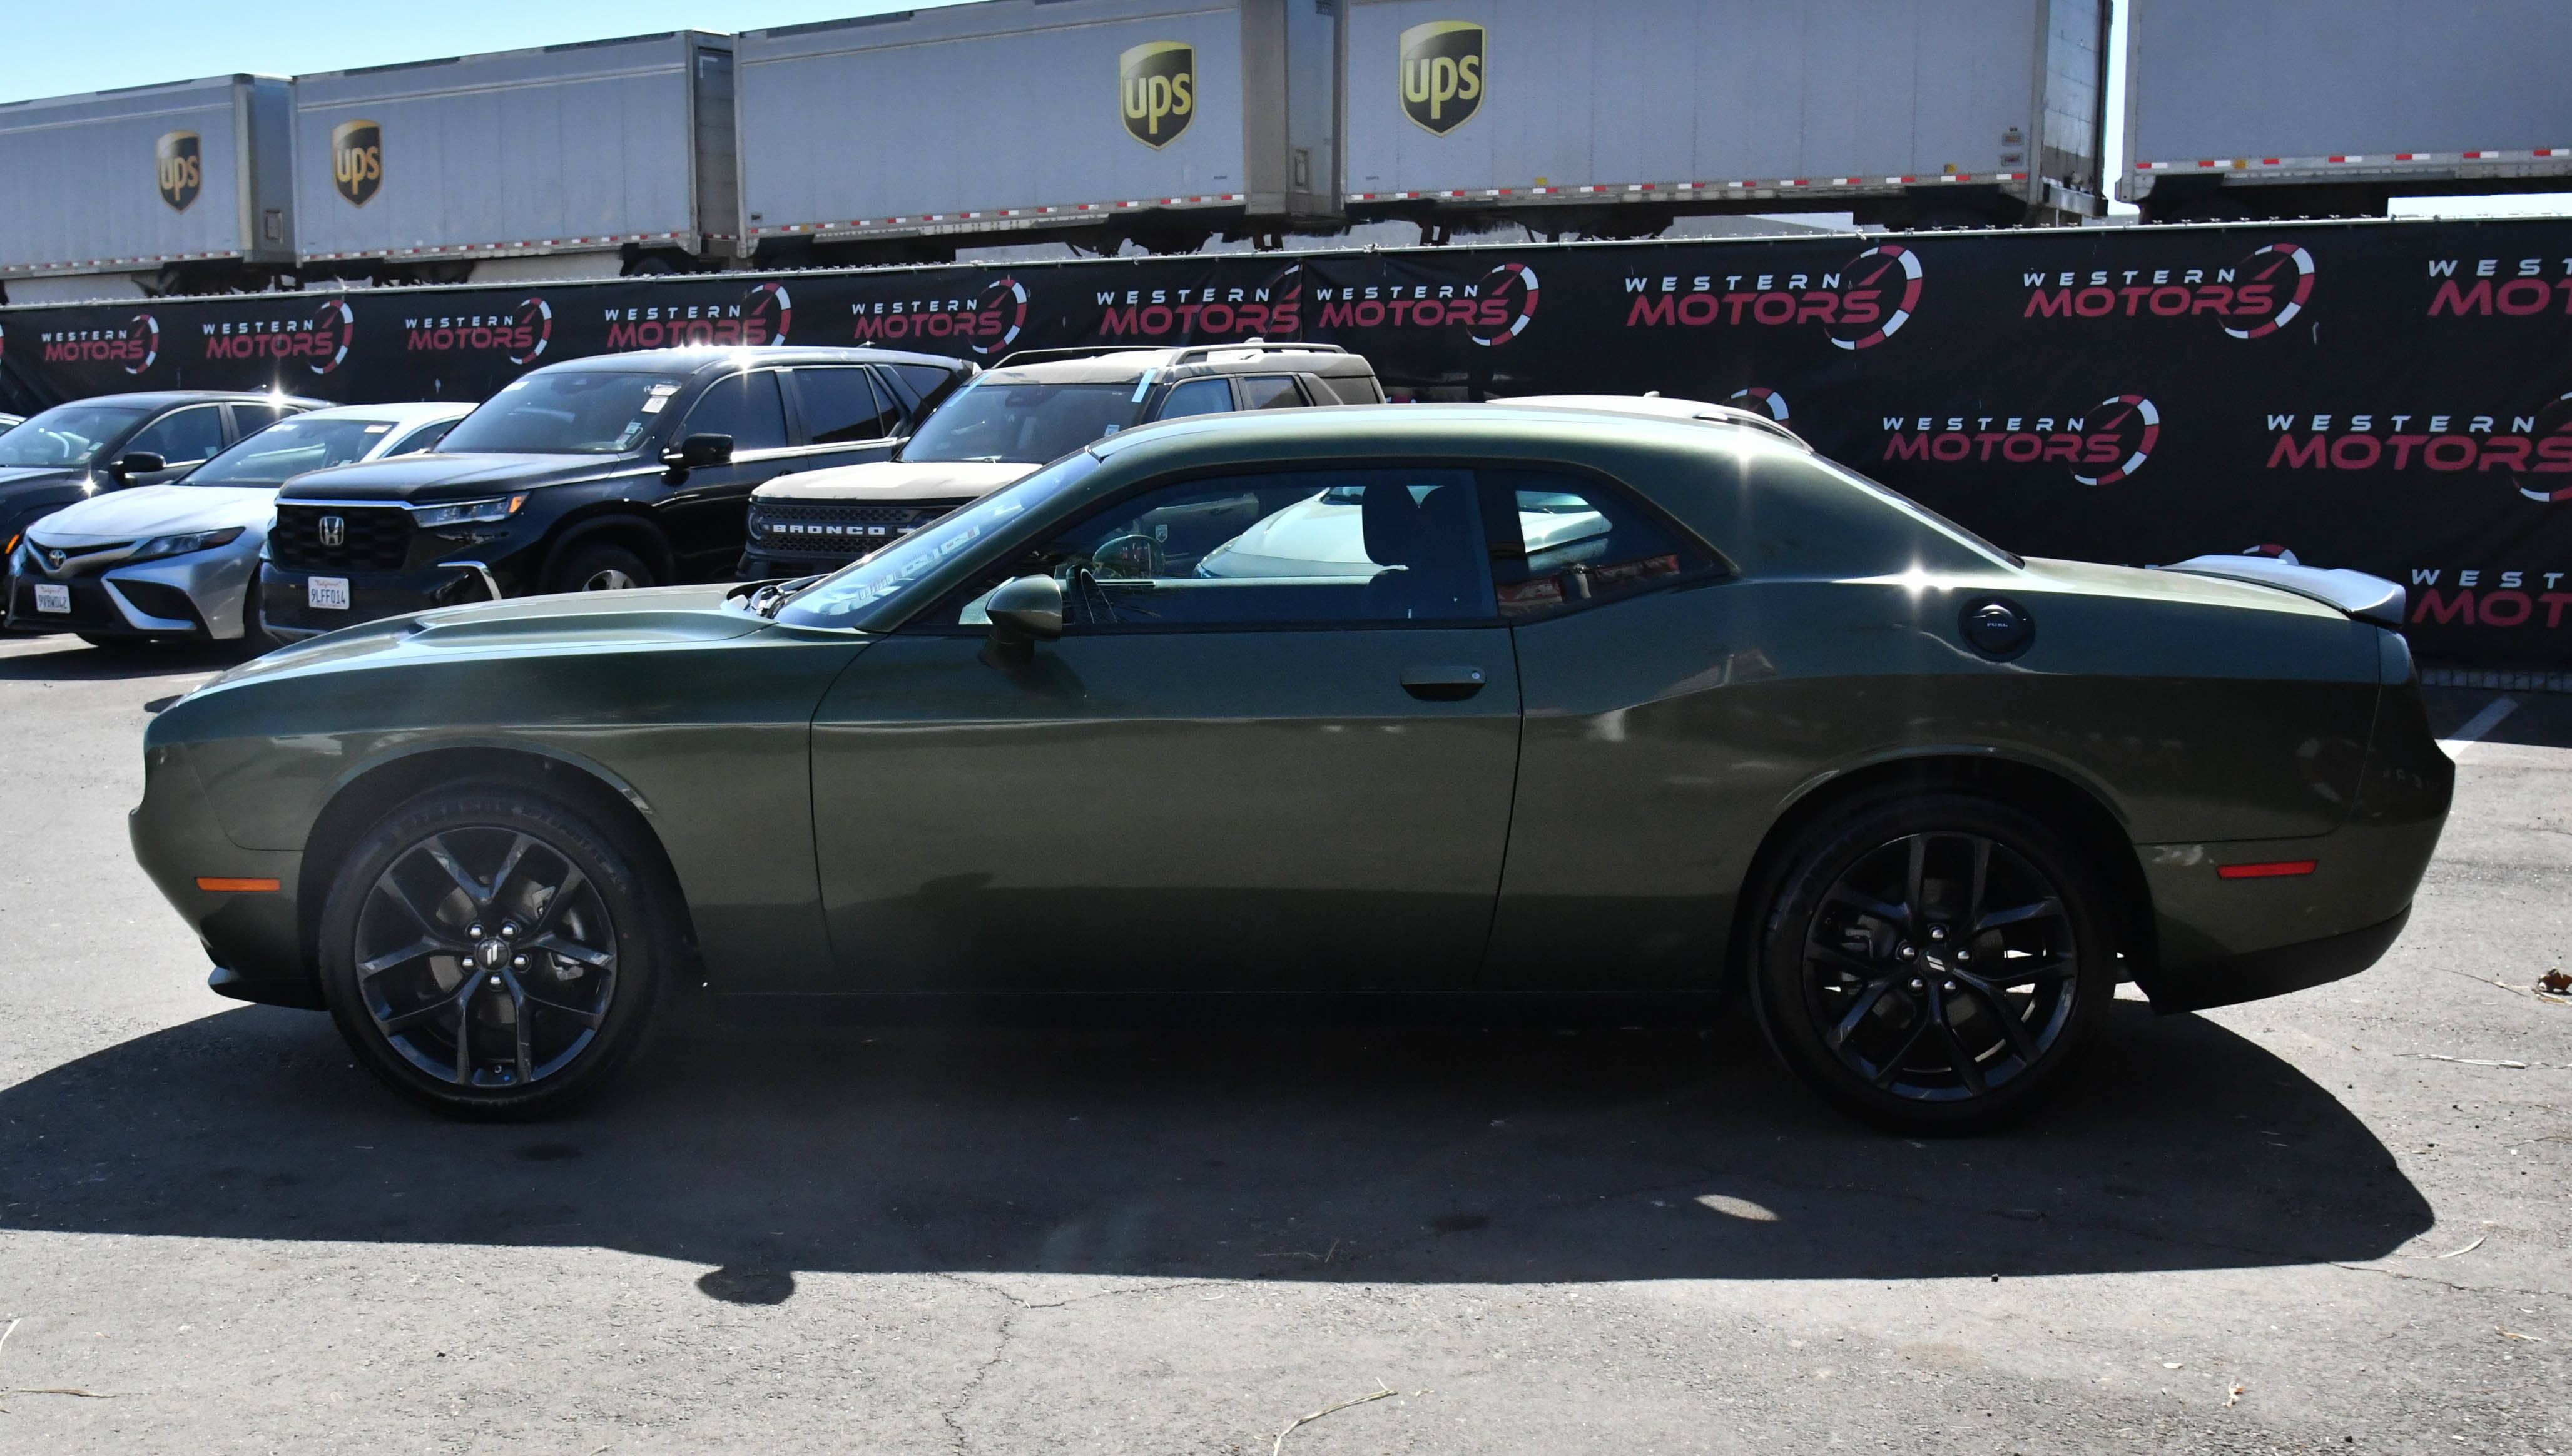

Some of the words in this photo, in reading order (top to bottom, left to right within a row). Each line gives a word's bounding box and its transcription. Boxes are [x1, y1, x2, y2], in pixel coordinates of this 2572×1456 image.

[1405, 55, 1480, 119] ups
[1126, 73, 1191, 134] ups
[161, 155, 198, 201] ups
[337, 146, 379, 195] ups
[1625, 273, 1841, 292] WESTERN
[2023, 268, 2235, 286] WESTERN
[1097, 288, 1269, 305] WESTERN
[1317, 285, 1478, 300] WESTERN
[2023, 285, 2275, 318] MOTORS
[605, 305, 741, 320] WESTERN
[852, 299, 977, 315] WESTERN
[1319, 299, 1508, 327] MOTORS
[1627, 290, 1881, 326] MOTORS
[203, 320, 313, 335] WESTERN
[405, 316, 513, 328] WESTERN
[855, 312, 1002, 338] MOTORS
[1099, 303, 1301, 335] MOTORS
[41, 330, 126, 342] WESTERN
[408, 326, 532, 350] MOTORS
[607, 318, 766, 346] MOTORS
[45, 340, 143, 361] MOTORS
[206, 332, 333, 358] MOTORS
[1883, 417, 2085, 431] WESTERN
[2267, 414, 2534, 433] WESTERN
[1883, 432, 2121, 462] MOTORS
[2267, 433, 2572, 472] MOTORS
[773, 525, 885, 535] BRONCO
[312, 589, 346, 604] 9LFF014
